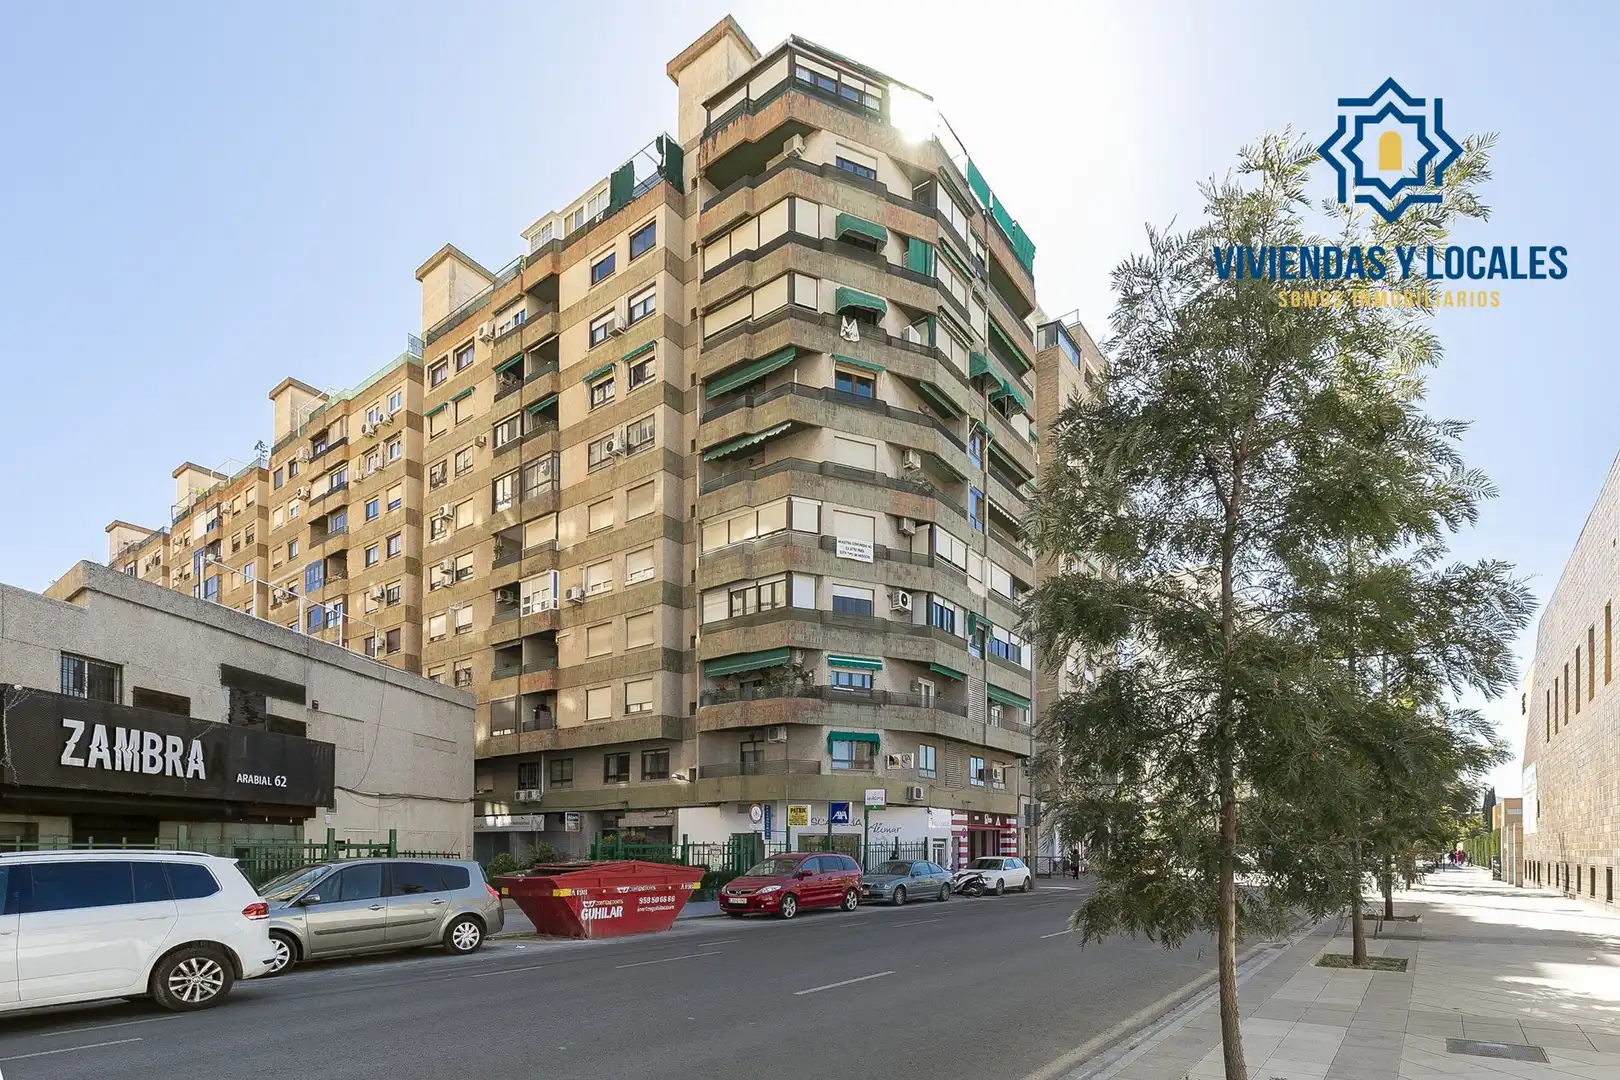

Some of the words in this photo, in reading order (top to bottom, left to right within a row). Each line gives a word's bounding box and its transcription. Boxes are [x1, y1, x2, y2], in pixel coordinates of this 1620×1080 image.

[60, 718, 207, 780] ZAMBRA
[236, 773, 273, 786] ARABIAL
[274, 775, 287, 788] 62
[832, 810, 848, 820] AXA
[580, 906, 623, 921] GUHILAR
